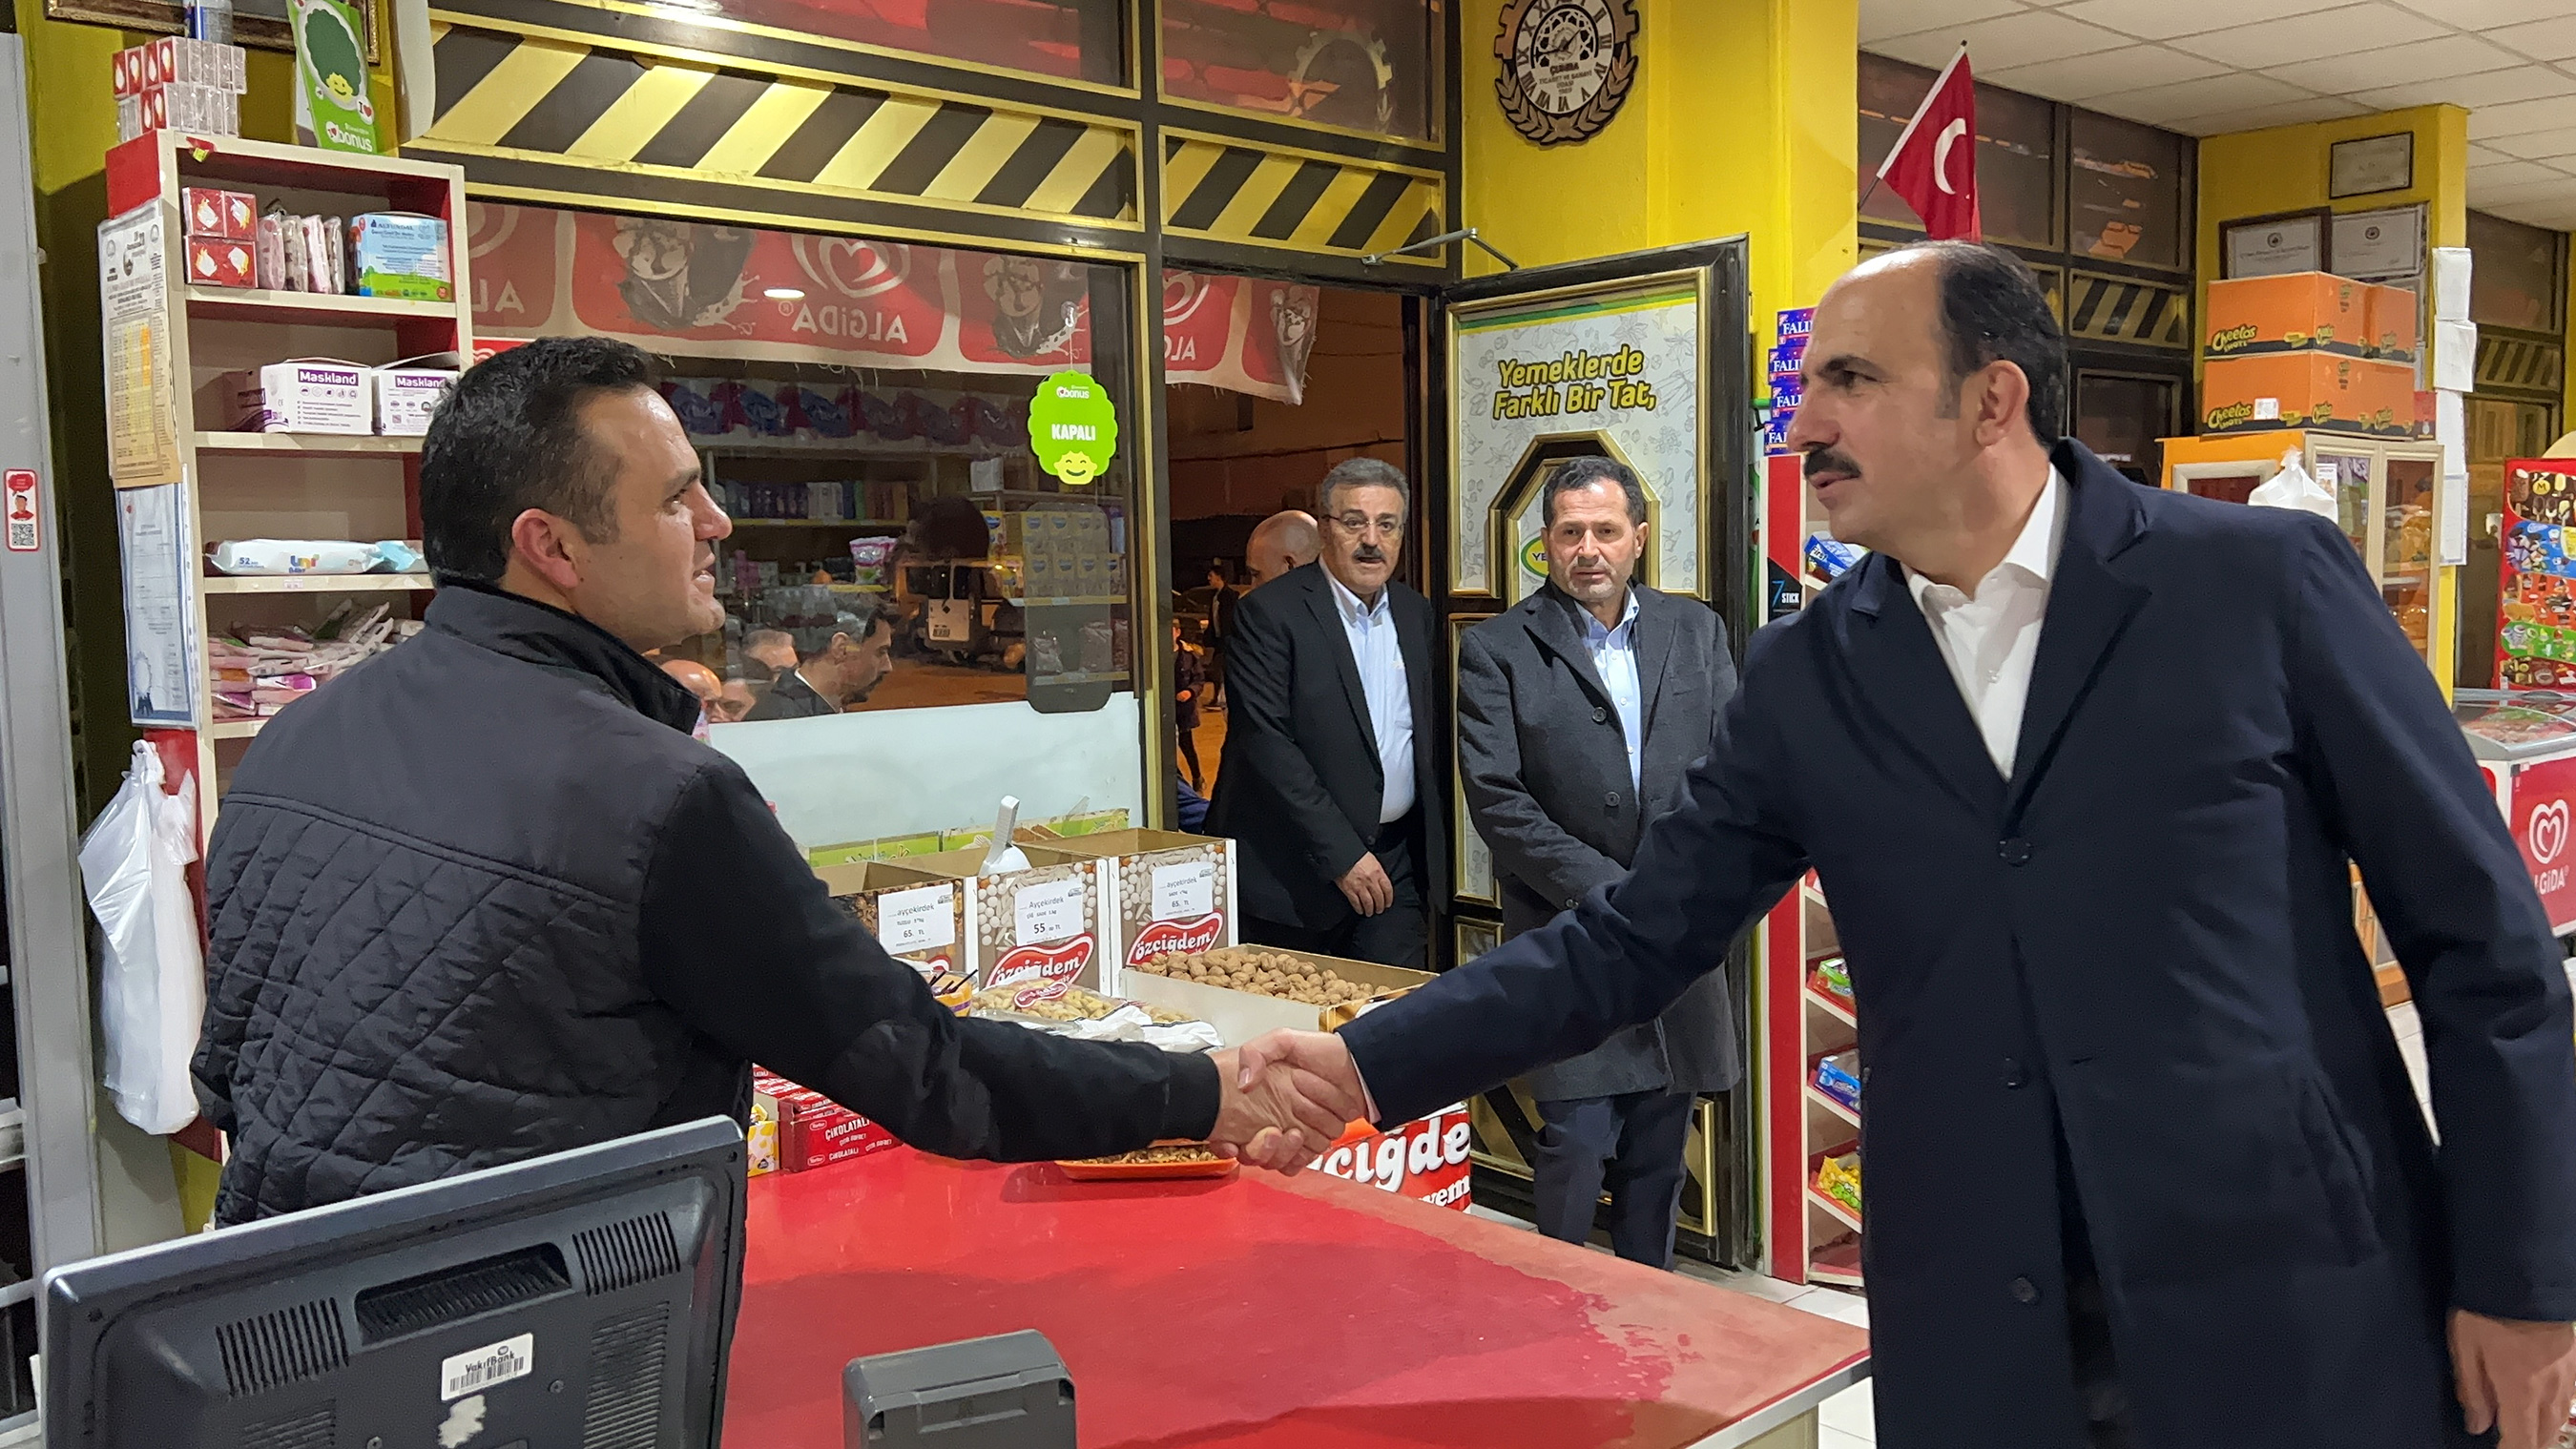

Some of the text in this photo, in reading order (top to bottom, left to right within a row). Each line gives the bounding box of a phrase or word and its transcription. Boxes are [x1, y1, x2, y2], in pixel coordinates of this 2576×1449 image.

[1782, 319, 1812, 335] FALI
[2212, 324, 2257, 352] Cheetos
[1498, 343, 1644, 388] Yemeklerde
[1773, 360, 1802, 373] FALI
[300, 370, 358, 385] Maskland
[1493, 378, 1657, 420] Farklı Bir Tat,
[1051, 424, 1096, 442] KAPALI
[239, 557, 251, 566] 52
[1033, 921, 1047, 935] 55
